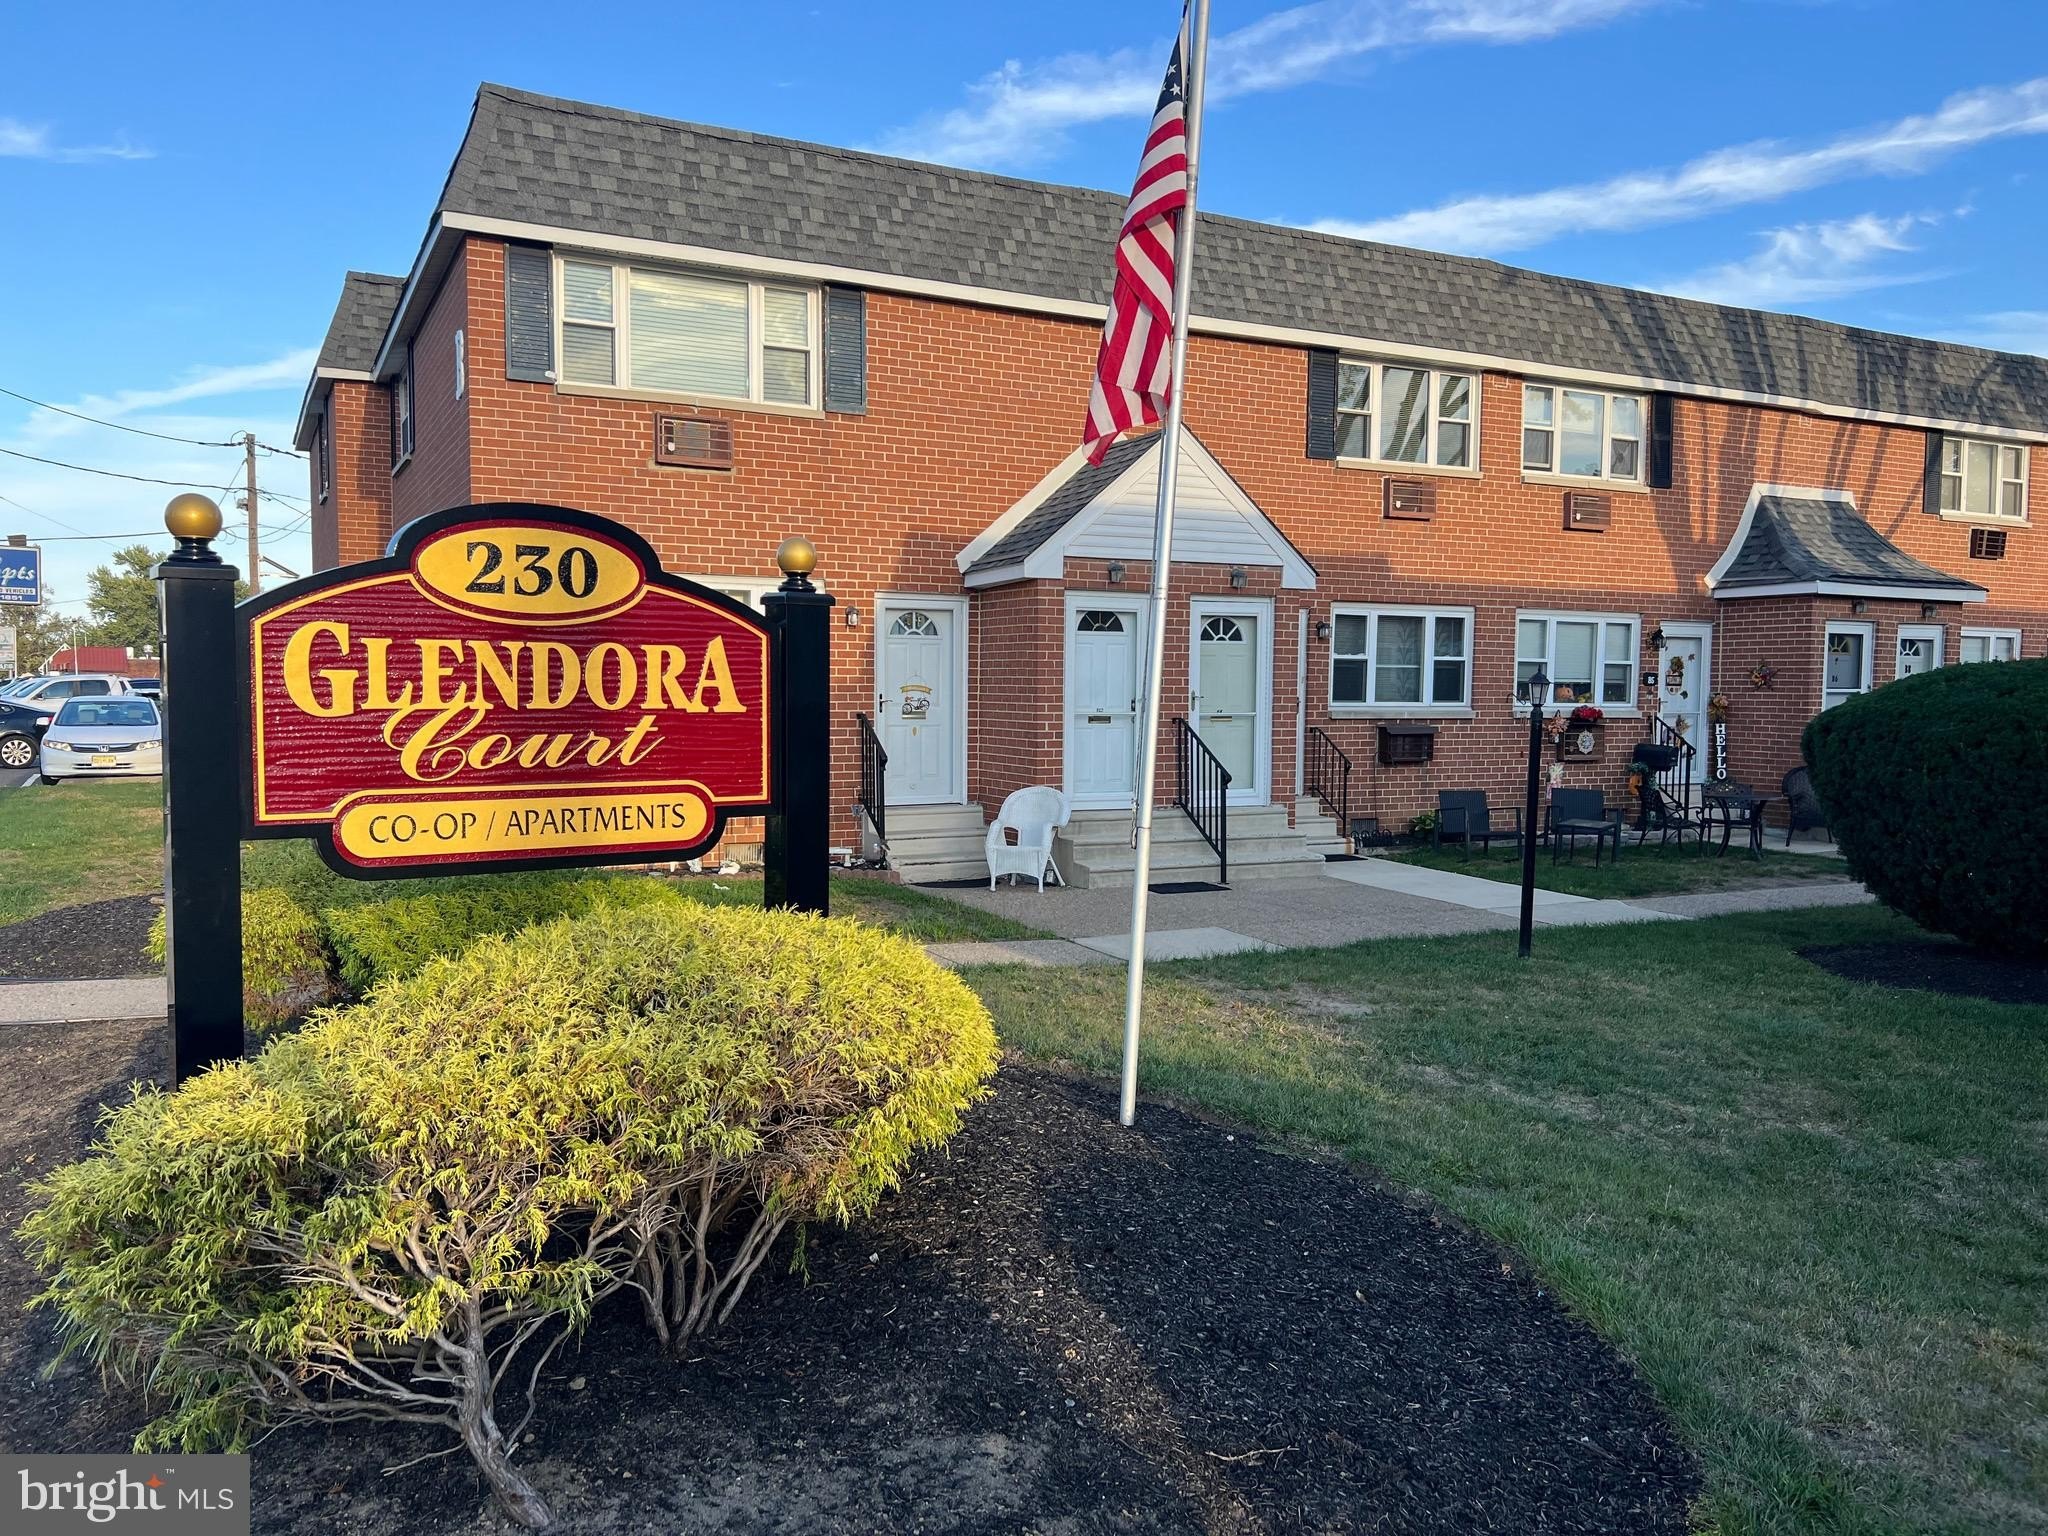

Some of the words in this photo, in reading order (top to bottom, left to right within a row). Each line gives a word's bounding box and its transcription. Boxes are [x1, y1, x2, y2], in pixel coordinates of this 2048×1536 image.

[464, 541, 599, 599] 230
[283, 621, 747, 718] GLENDORA
[383, 681, 665, 782] Court
[1715, 723, 1727, 780] HELLO
[369, 812, 477, 844] CO-OP
[504, 803, 687, 837] APARTMENTS
